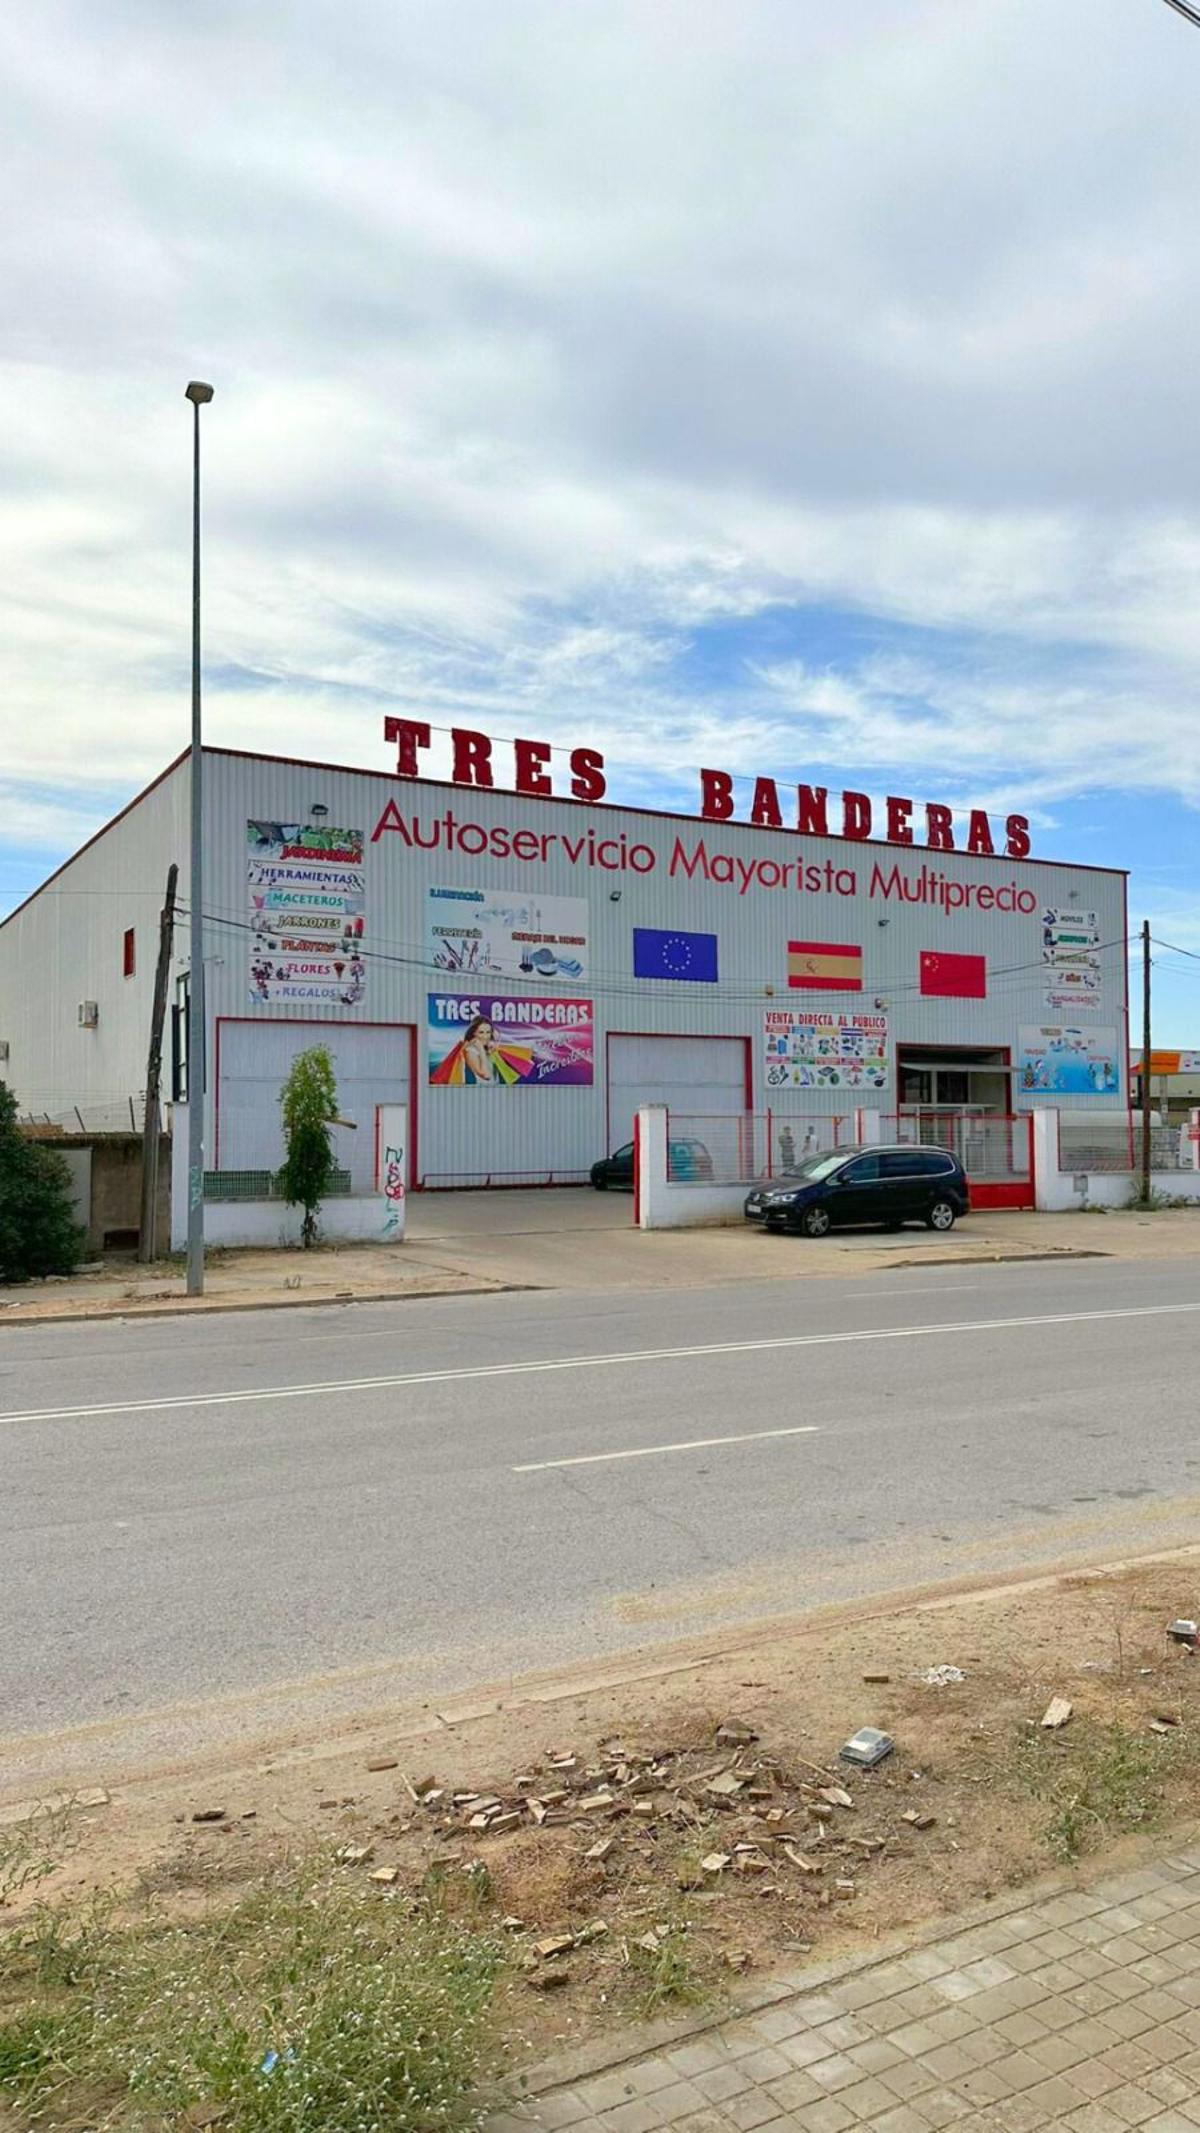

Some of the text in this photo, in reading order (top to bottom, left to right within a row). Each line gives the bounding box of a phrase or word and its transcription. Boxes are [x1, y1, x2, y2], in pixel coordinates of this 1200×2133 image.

[384, 715, 1031, 858] TRES BANDERAS
[370, 798, 1036, 916] Autoservicio Mayorista Multiprecio
[261, 867, 353, 884] HERRAMIENTAS
[273, 892, 343, 906] MACETEROS
[277, 915, 341, 929] JARRONES
[287, 963, 331, 975] FLORES
[282, 987, 336, 998] REGALOS
[436, 1000, 589, 1024] TRES BANDERAS
[766, 1012, 794, 1024] VENTA
[799, 1013, 834, 1026] DIRECTA
[838, 1015, 848, 1026] AL
